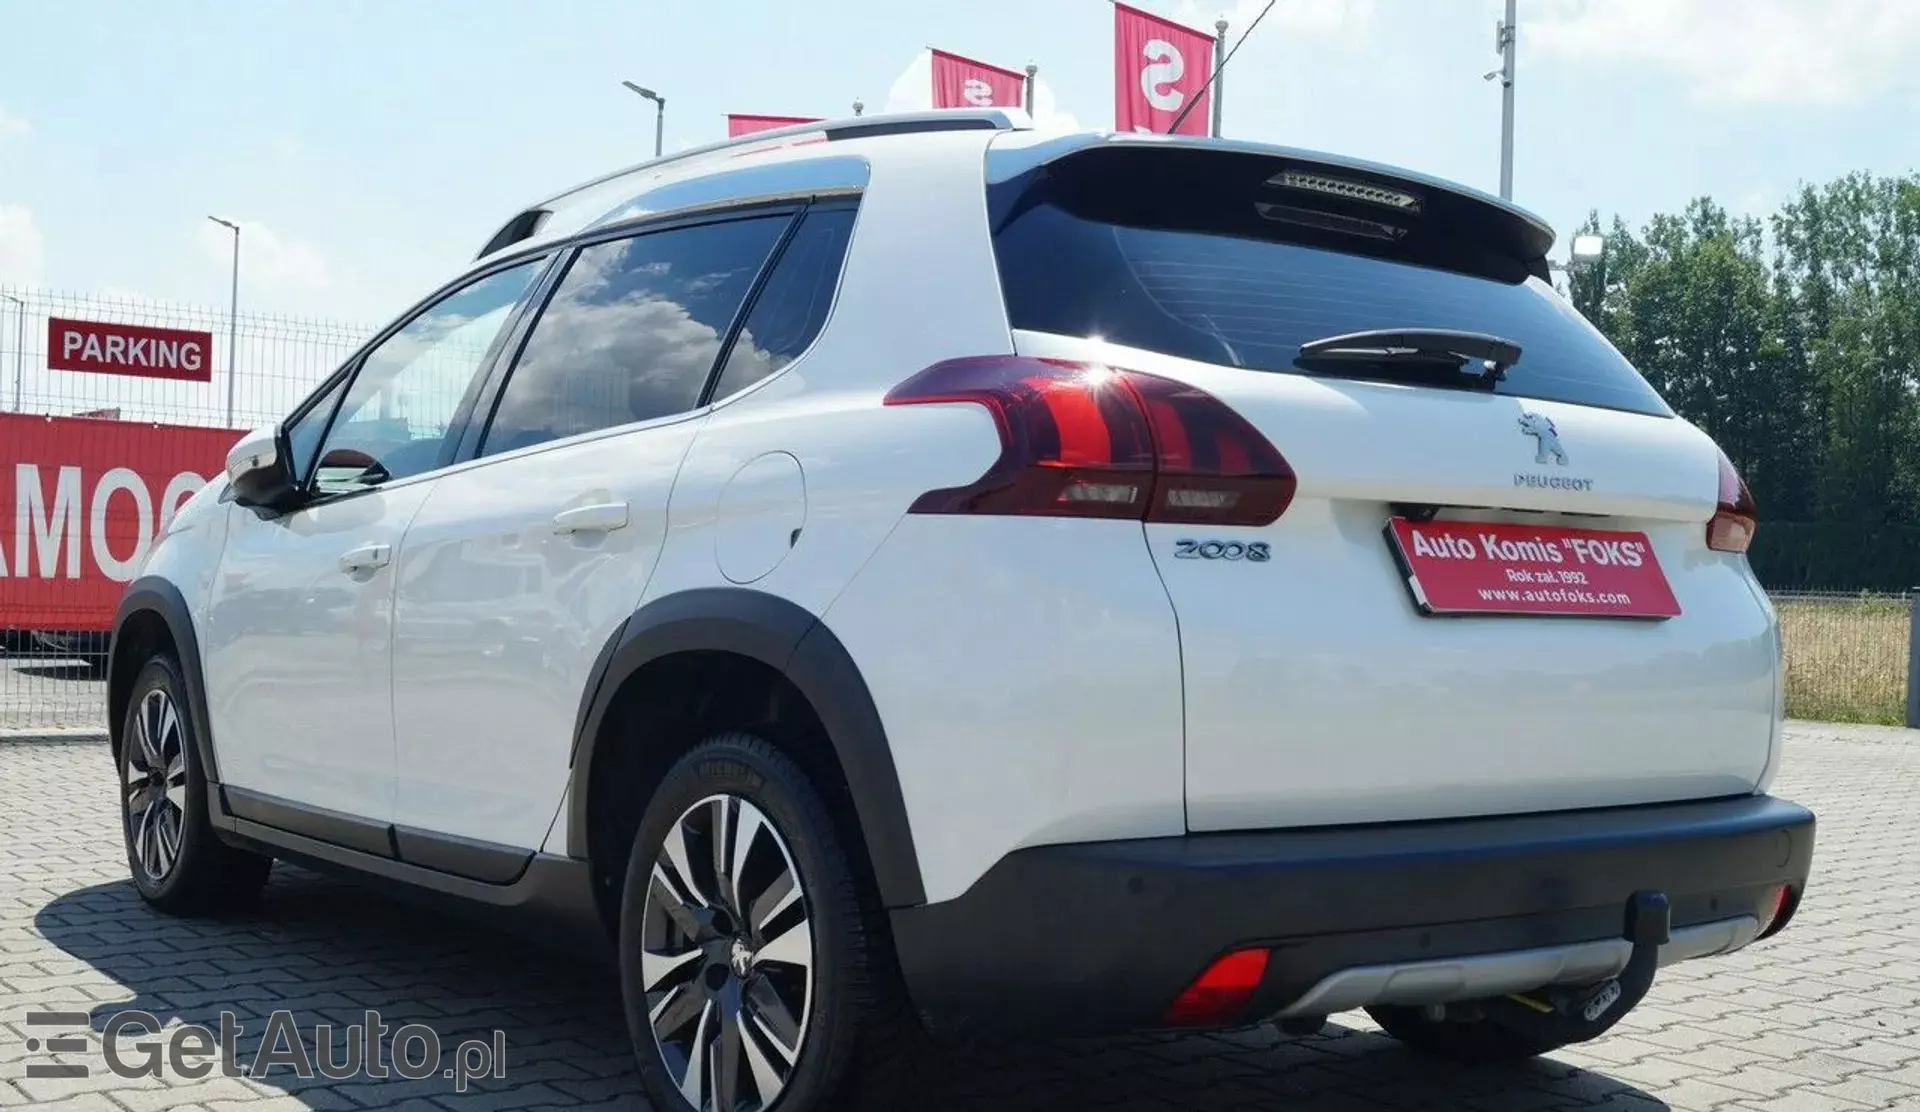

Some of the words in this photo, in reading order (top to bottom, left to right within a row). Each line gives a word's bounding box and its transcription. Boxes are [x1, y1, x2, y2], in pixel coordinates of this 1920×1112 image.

[63, 330, 202, 371] PARKING
[1512, 473, 1594, 492] PEUGEOT
[0, 463, 207, 582] MO
[1174, 538, 1271, 562] 2008
[1411, 529, 1477, 560] Auto
[1478, 533, 1564, 563] Komis
[1564, 537, 1645, 568] "FOKS"
[1505, 568, 1534, 582] Rok
[1558, 570, 1589, 585] 1992
[1477, 588, 1632, 605] www.autofoks.com
